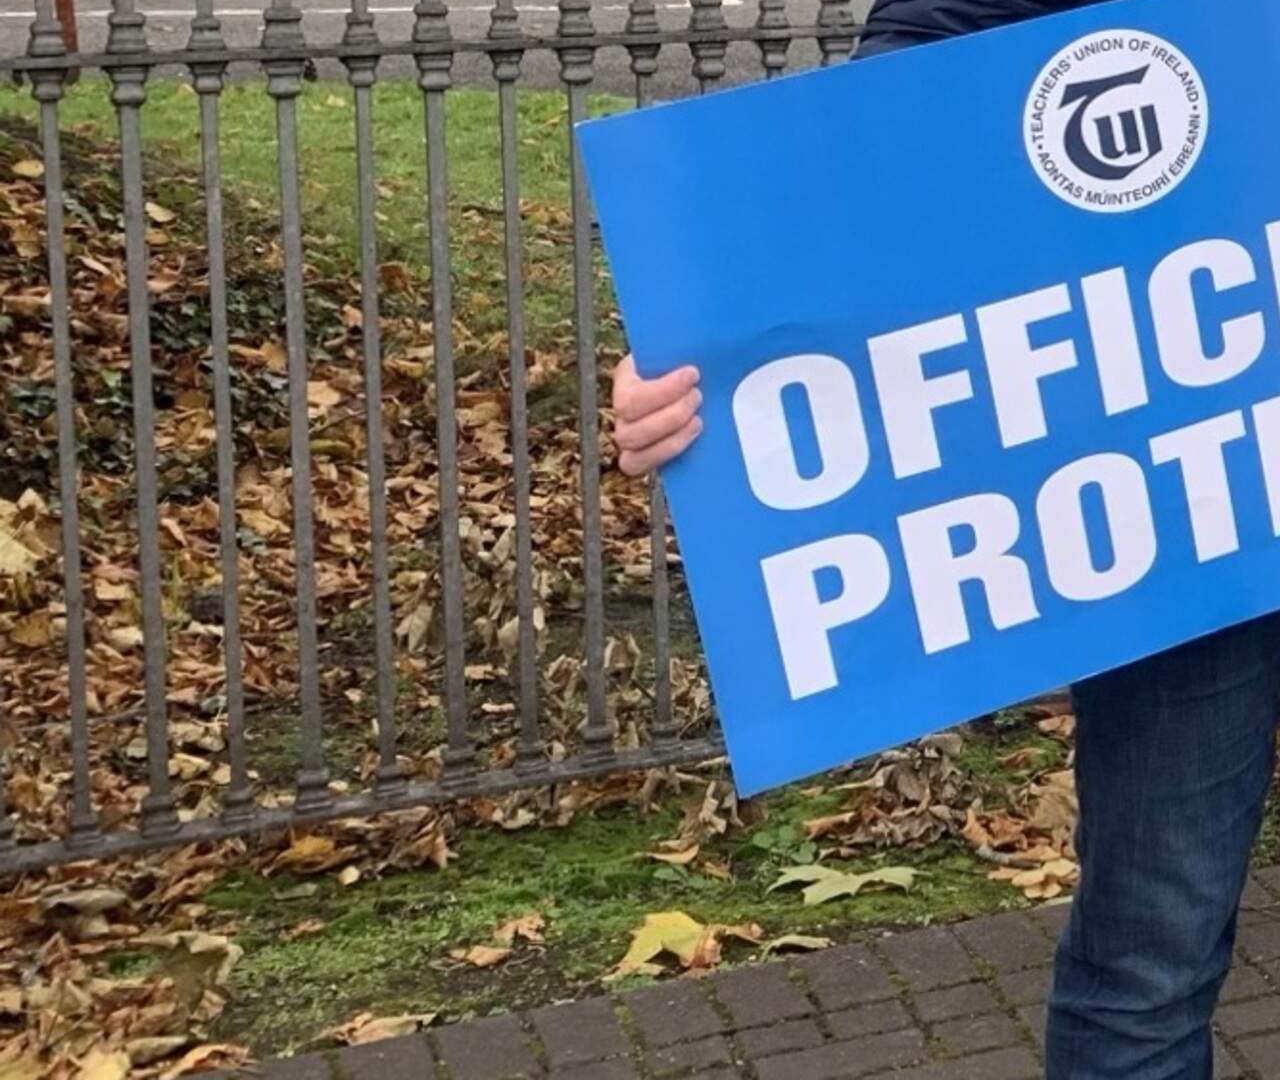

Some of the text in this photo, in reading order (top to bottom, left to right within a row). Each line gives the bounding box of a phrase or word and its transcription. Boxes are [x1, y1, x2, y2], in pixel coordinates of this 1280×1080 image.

[1073, 37, 1125, 62] UNION
[1128, 38, 1152, 52] OF
[1152, 45, 1200, 103] IRELAND
[1038, 151, 1084, 198] AONTAS
